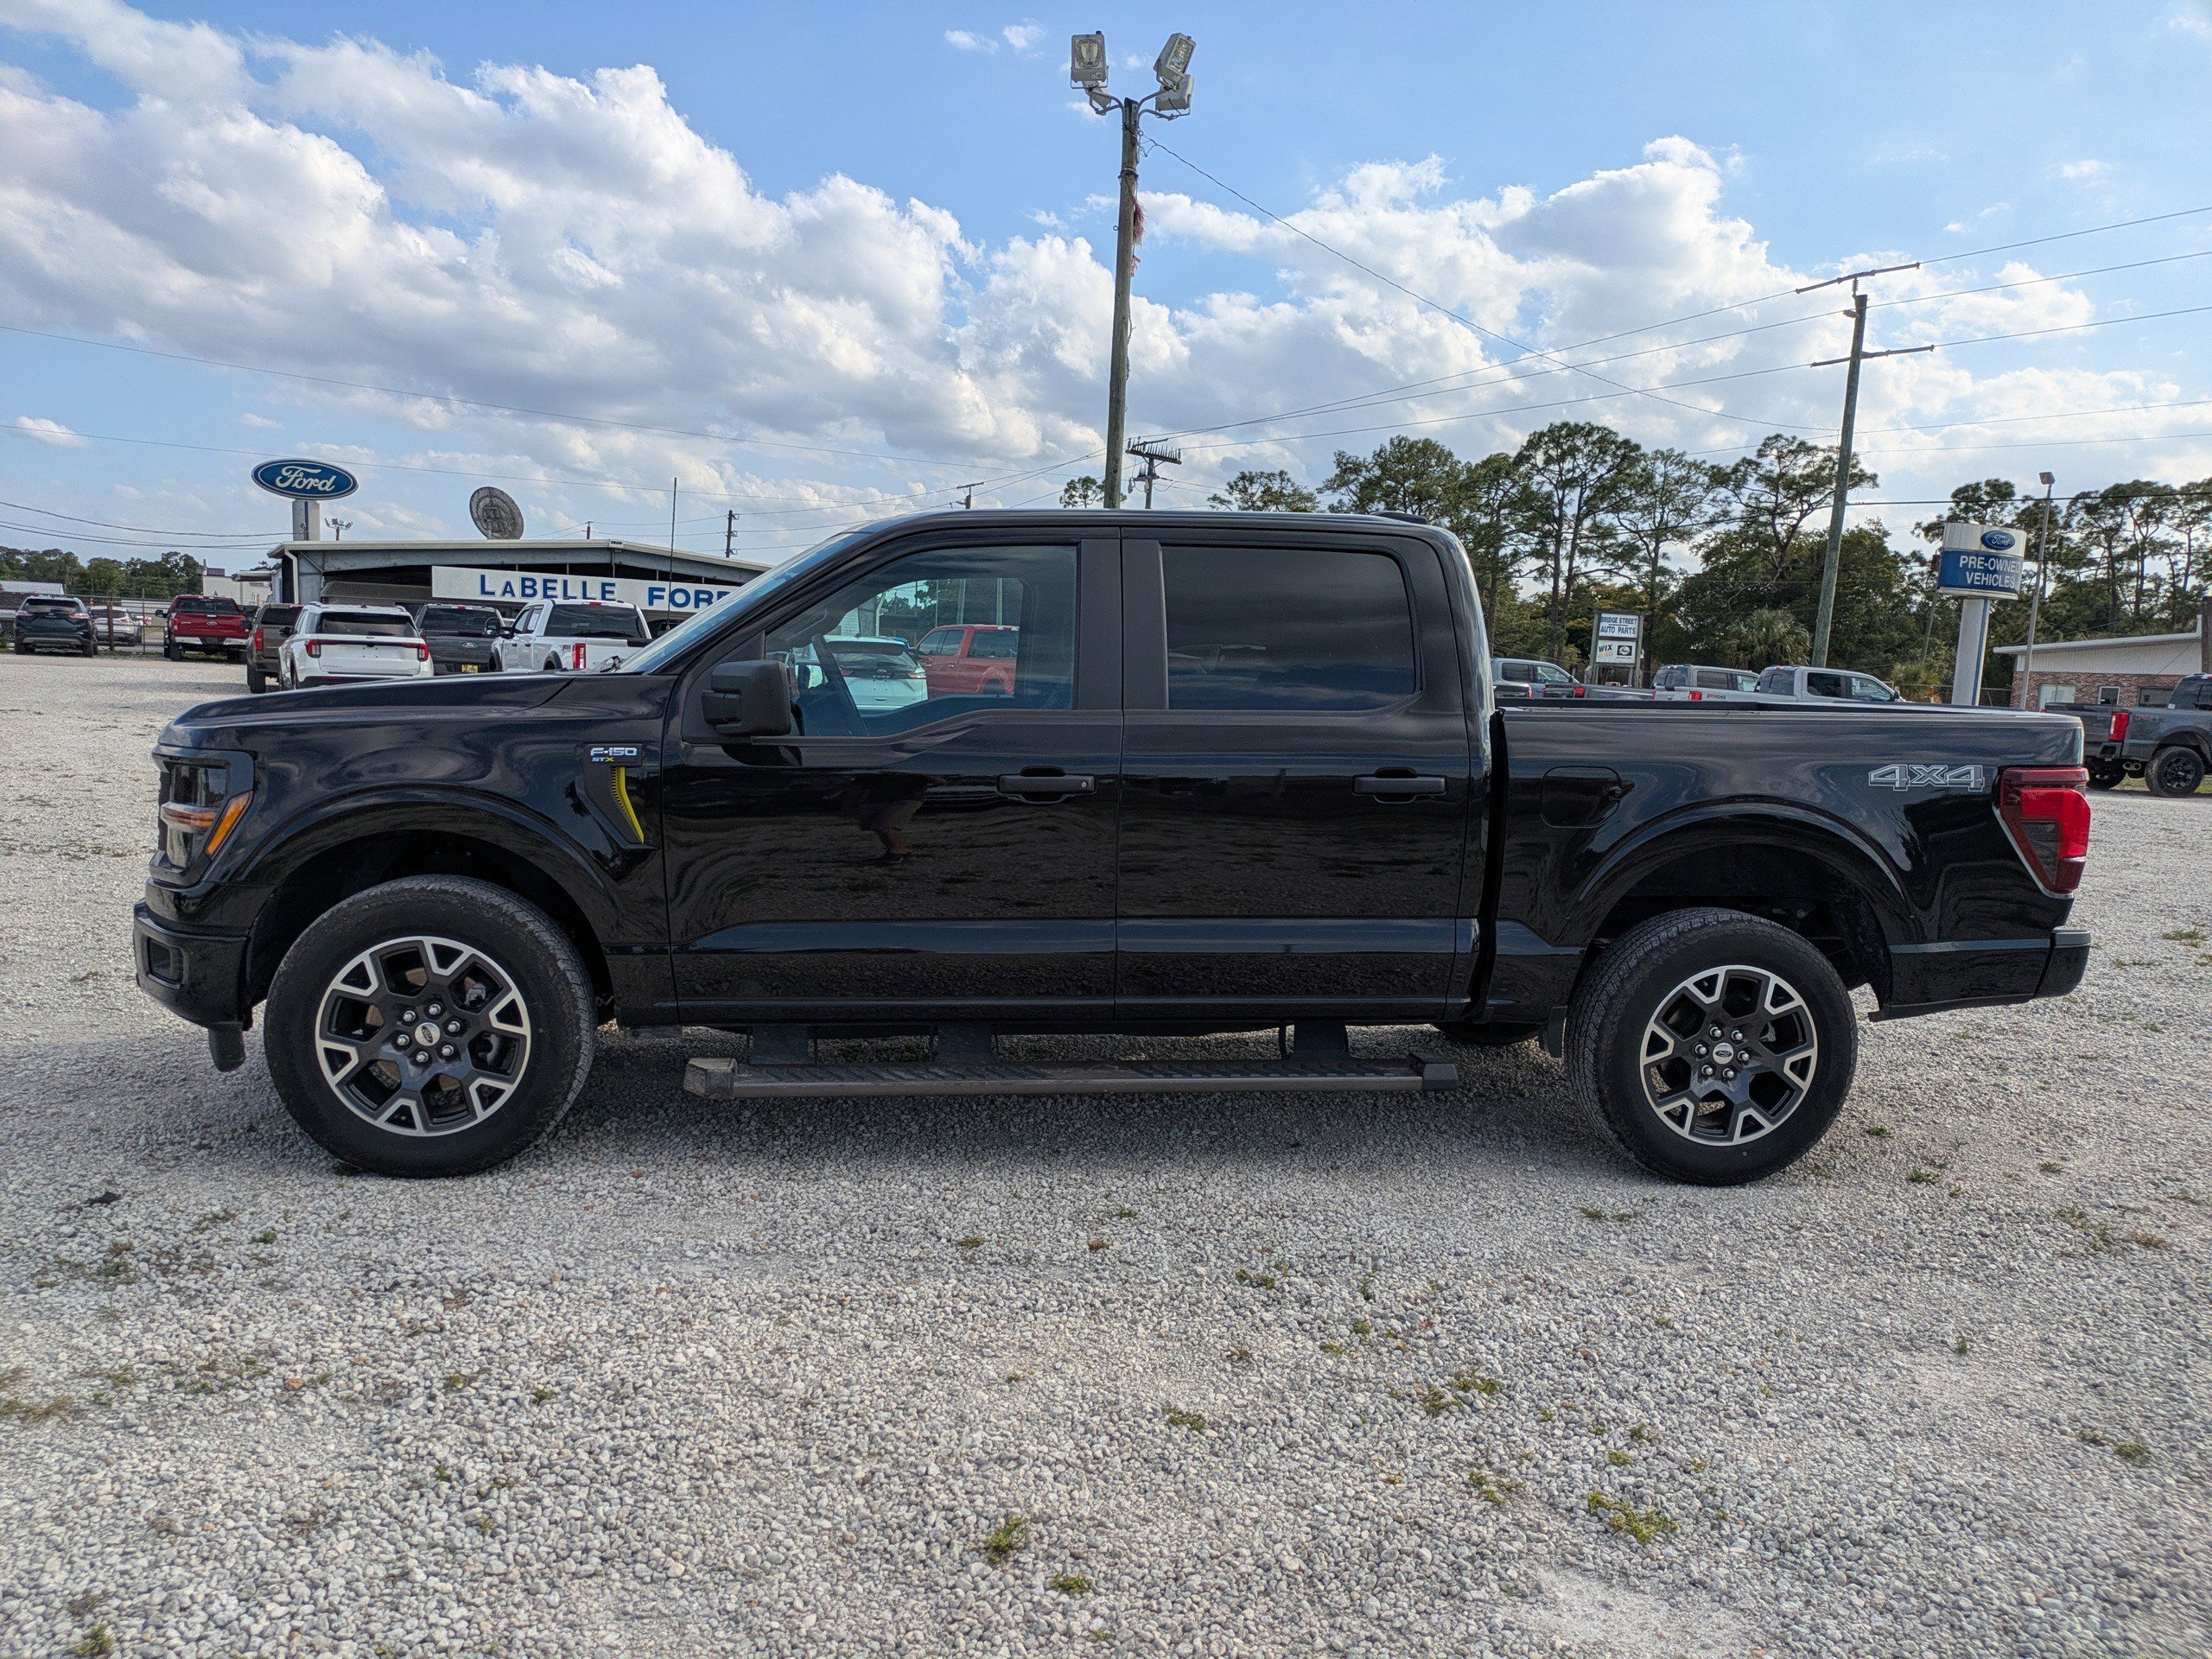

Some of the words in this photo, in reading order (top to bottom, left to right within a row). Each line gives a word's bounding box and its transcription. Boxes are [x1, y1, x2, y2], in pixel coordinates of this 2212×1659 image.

[275, 466, 337, 492] Ford
[1992, 534, 2010, 546] Ford
[1959, 555, 2021, 573] PRE-OWNED
[1966, 571, 2015, 588] VEHICLES
[1618, 626, 1637, 635] PARTS
[1599, 644, 1613, 652] WIX
[590, 747, 638, 756] F-150
